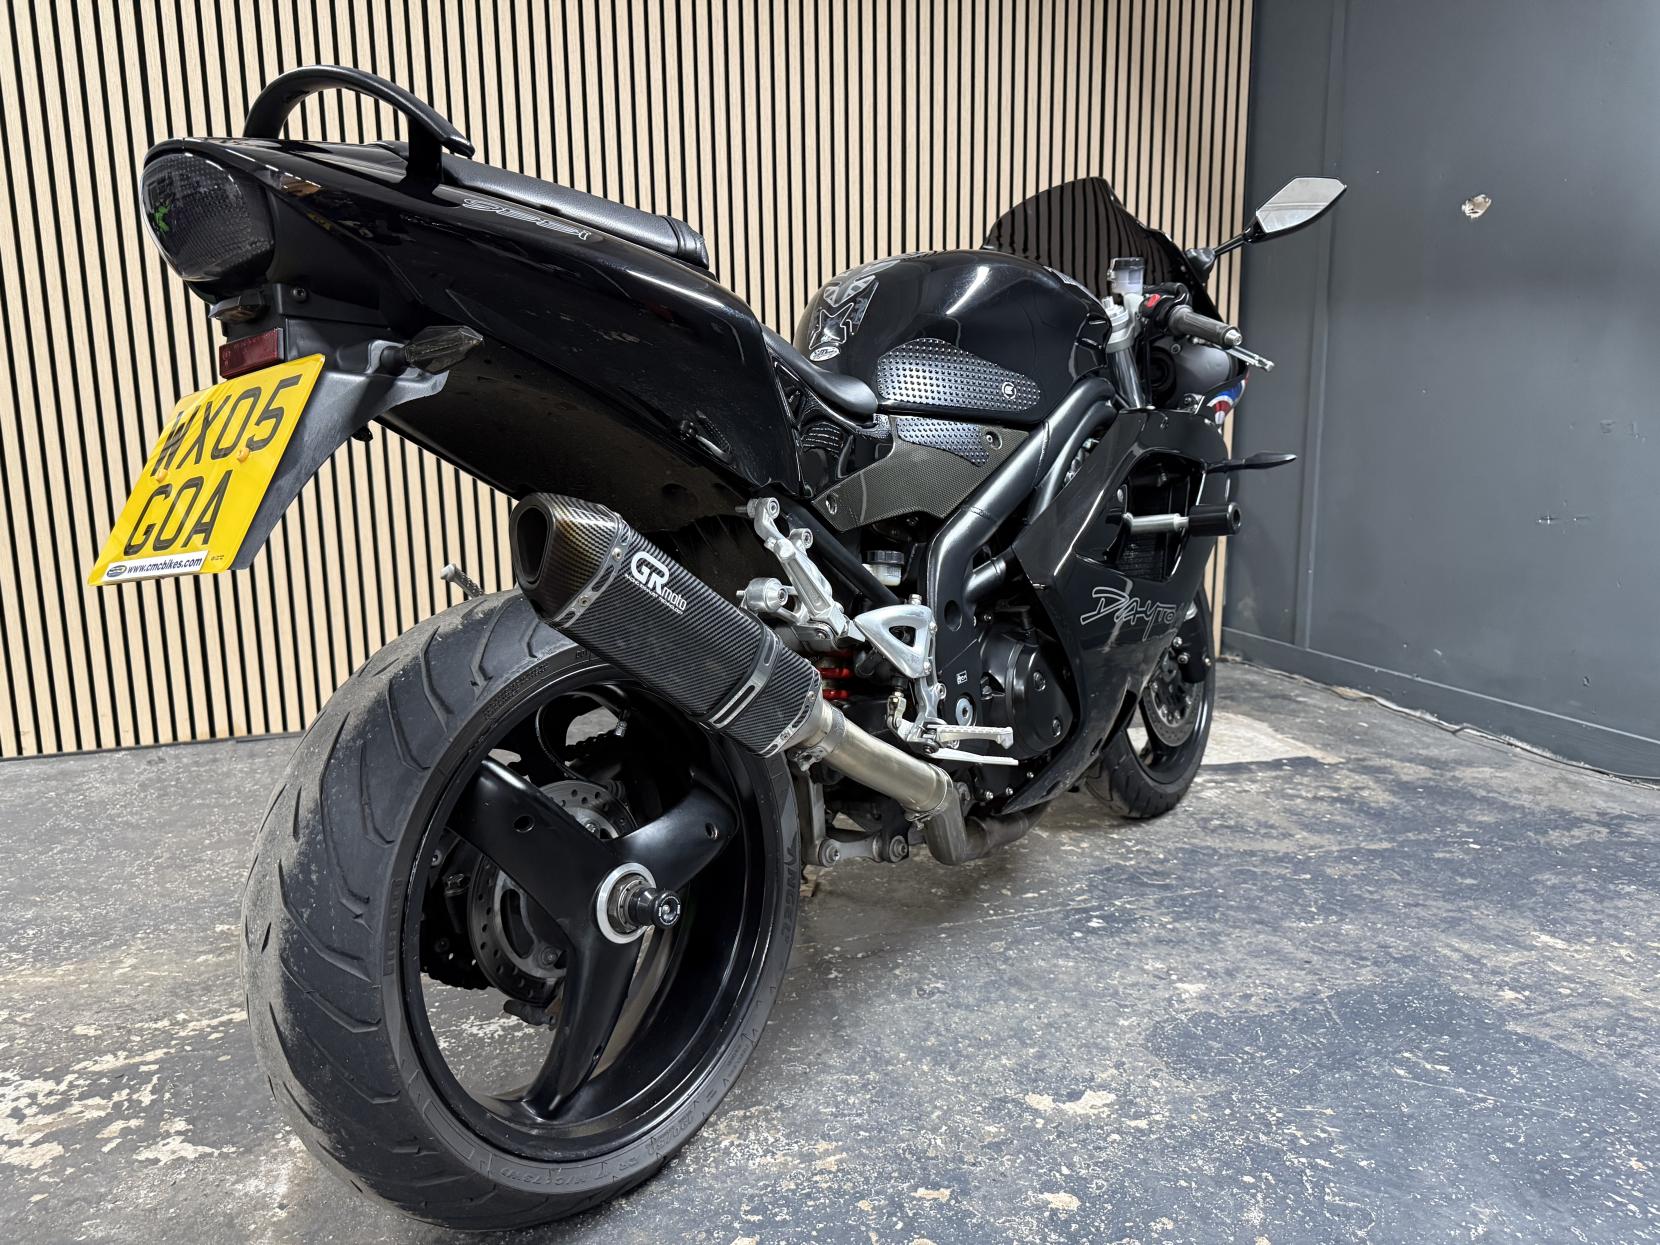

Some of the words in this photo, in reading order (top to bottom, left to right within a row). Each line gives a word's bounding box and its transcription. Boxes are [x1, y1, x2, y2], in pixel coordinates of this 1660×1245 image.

[150, 373, 303, 477] WX05
[123, 469, 233, 557] GOA
[127, 557, 203, 574] www.cmcbikes.com
